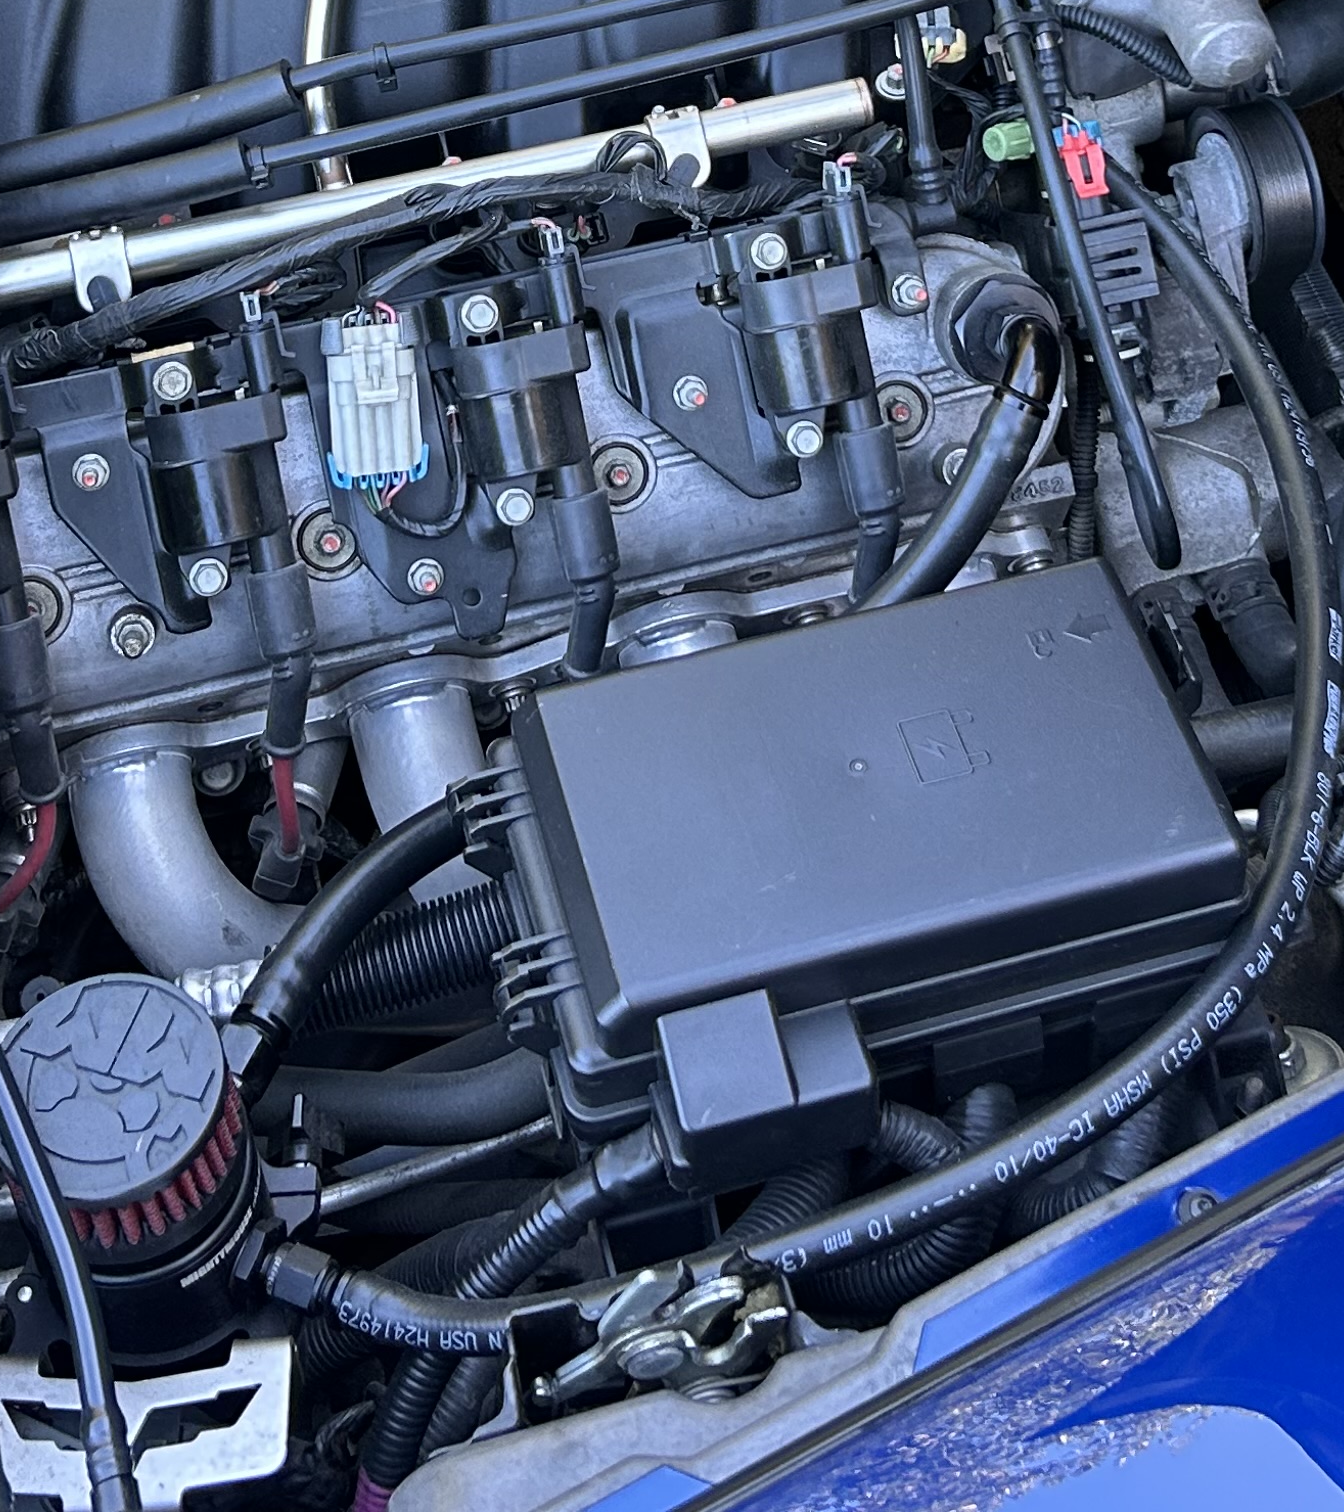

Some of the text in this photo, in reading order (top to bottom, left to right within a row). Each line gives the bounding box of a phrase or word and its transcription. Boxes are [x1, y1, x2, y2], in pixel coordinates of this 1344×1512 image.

[1299, 771, 1332, 871] 801-6-BLK
[1292, 870, 1309, 902] WP
[1269, 899, 1296, 943] 2,4
[1243, 941, 1275, 980] MPa
[1206, 984, 1243, 1032] (350
[1160, 1027, 1204, 1075] PSI)
[1102, 1069, 1153, 1118] MSHA
[994, 1109, 1096, 1183] IC-40/10
[822, 1227, 854, 1255] mm
[866, 1213, 895, 1242] 10
[337, 1302, 506, 1351] N USA H2414973
